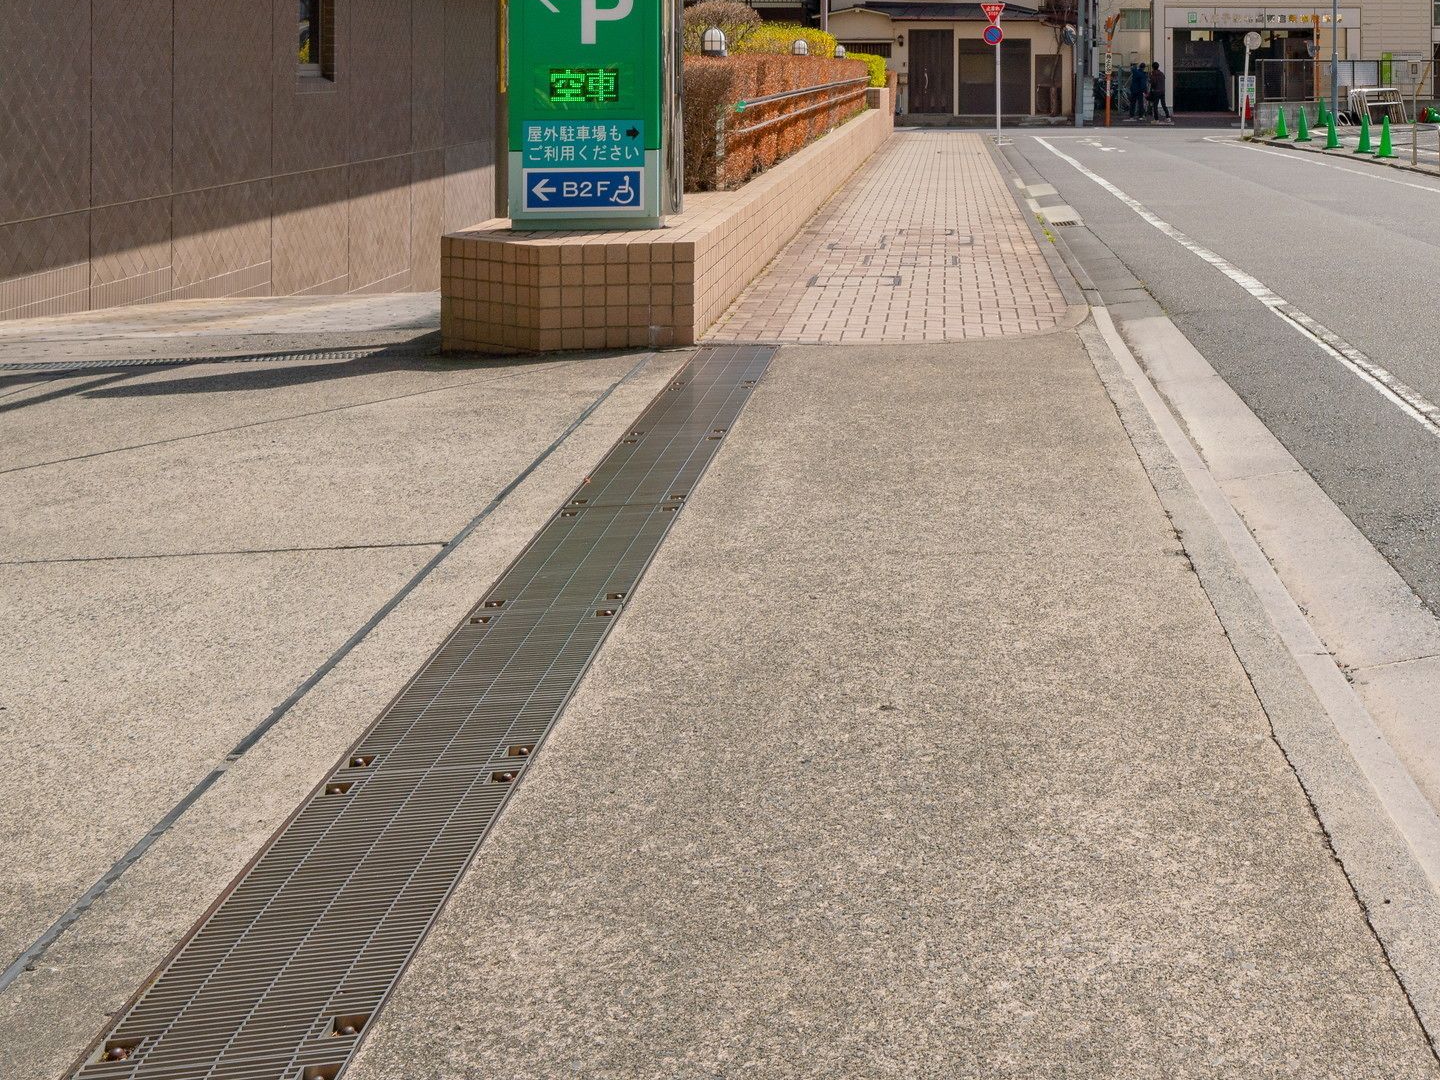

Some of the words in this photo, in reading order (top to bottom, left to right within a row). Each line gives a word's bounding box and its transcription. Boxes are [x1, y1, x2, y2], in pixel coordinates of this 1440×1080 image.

[550, 69, 617, 102] 空車
[527, 125, 622, 143] 屋外駐車場も
[528, 145, 640, 162] ご利用ください
[562, 181, 611, 198] B2F
